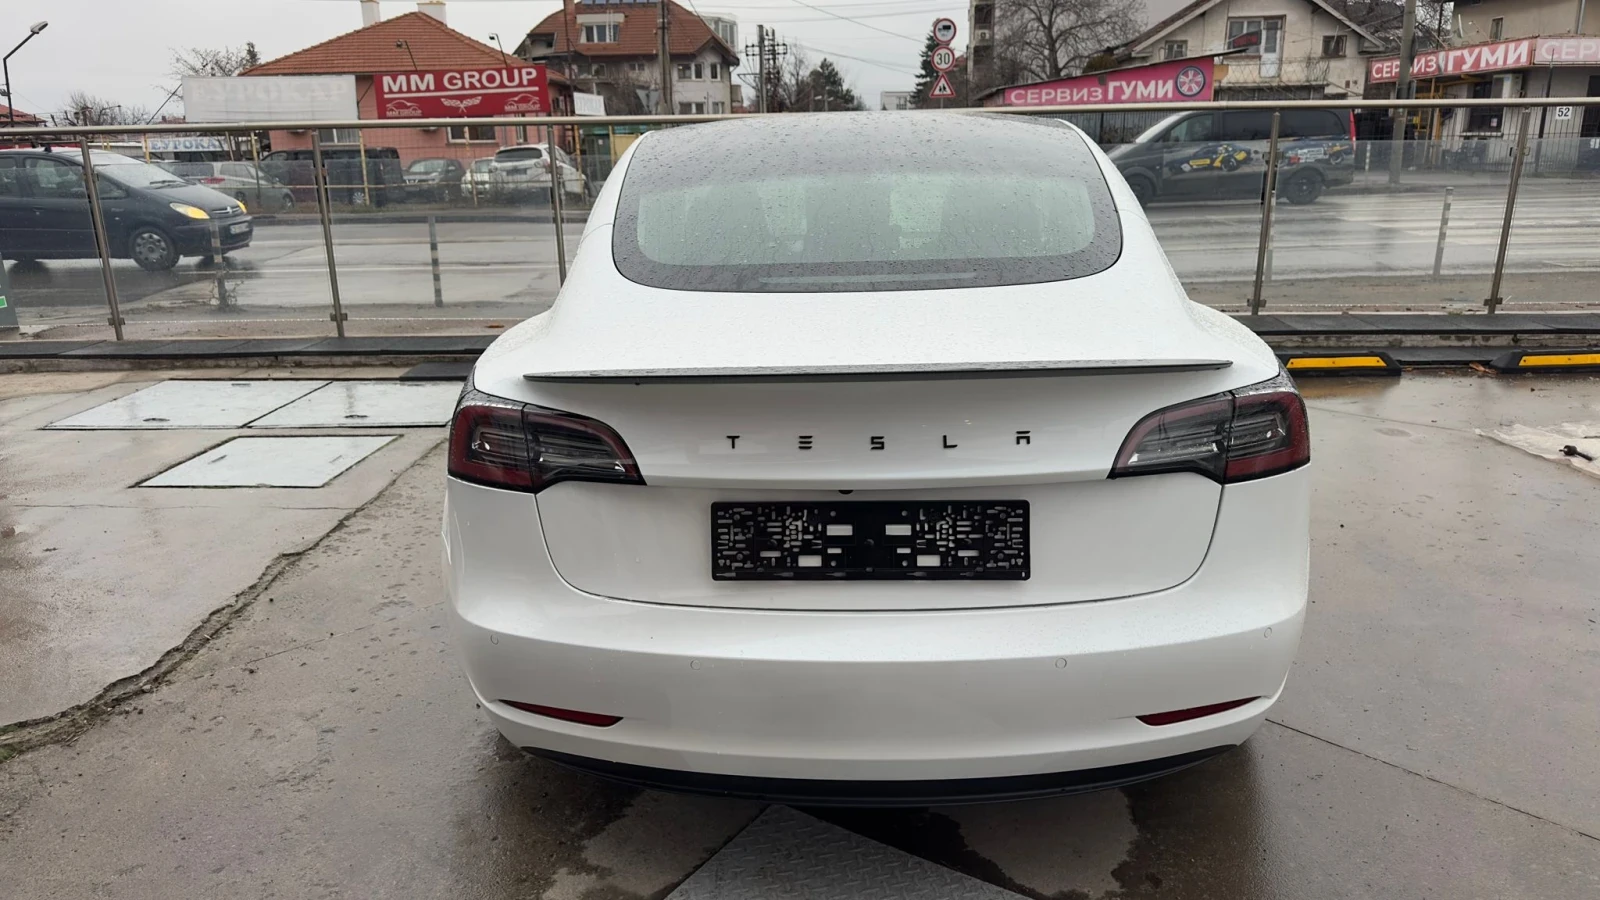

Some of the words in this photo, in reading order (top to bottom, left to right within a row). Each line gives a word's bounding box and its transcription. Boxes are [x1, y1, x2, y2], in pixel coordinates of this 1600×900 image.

[936, 53, 950, 65] 30
[1372, 55, 1437, 78] СЕРИЗ
[1447, 40, 1529, 71] ГУМИ
[1541, 40, 1600, 60] СЕР
[382, 73, 435, 92] MM
[443, 68, 537, 89] GROUP
[1010, 87, 1103, 104] СЕРВИЗ
[1108, 79, 1173, 100] ГУМИ
[1557, 107, 1571, 117] 52
[726, 430, 1031, 450] TESLA
